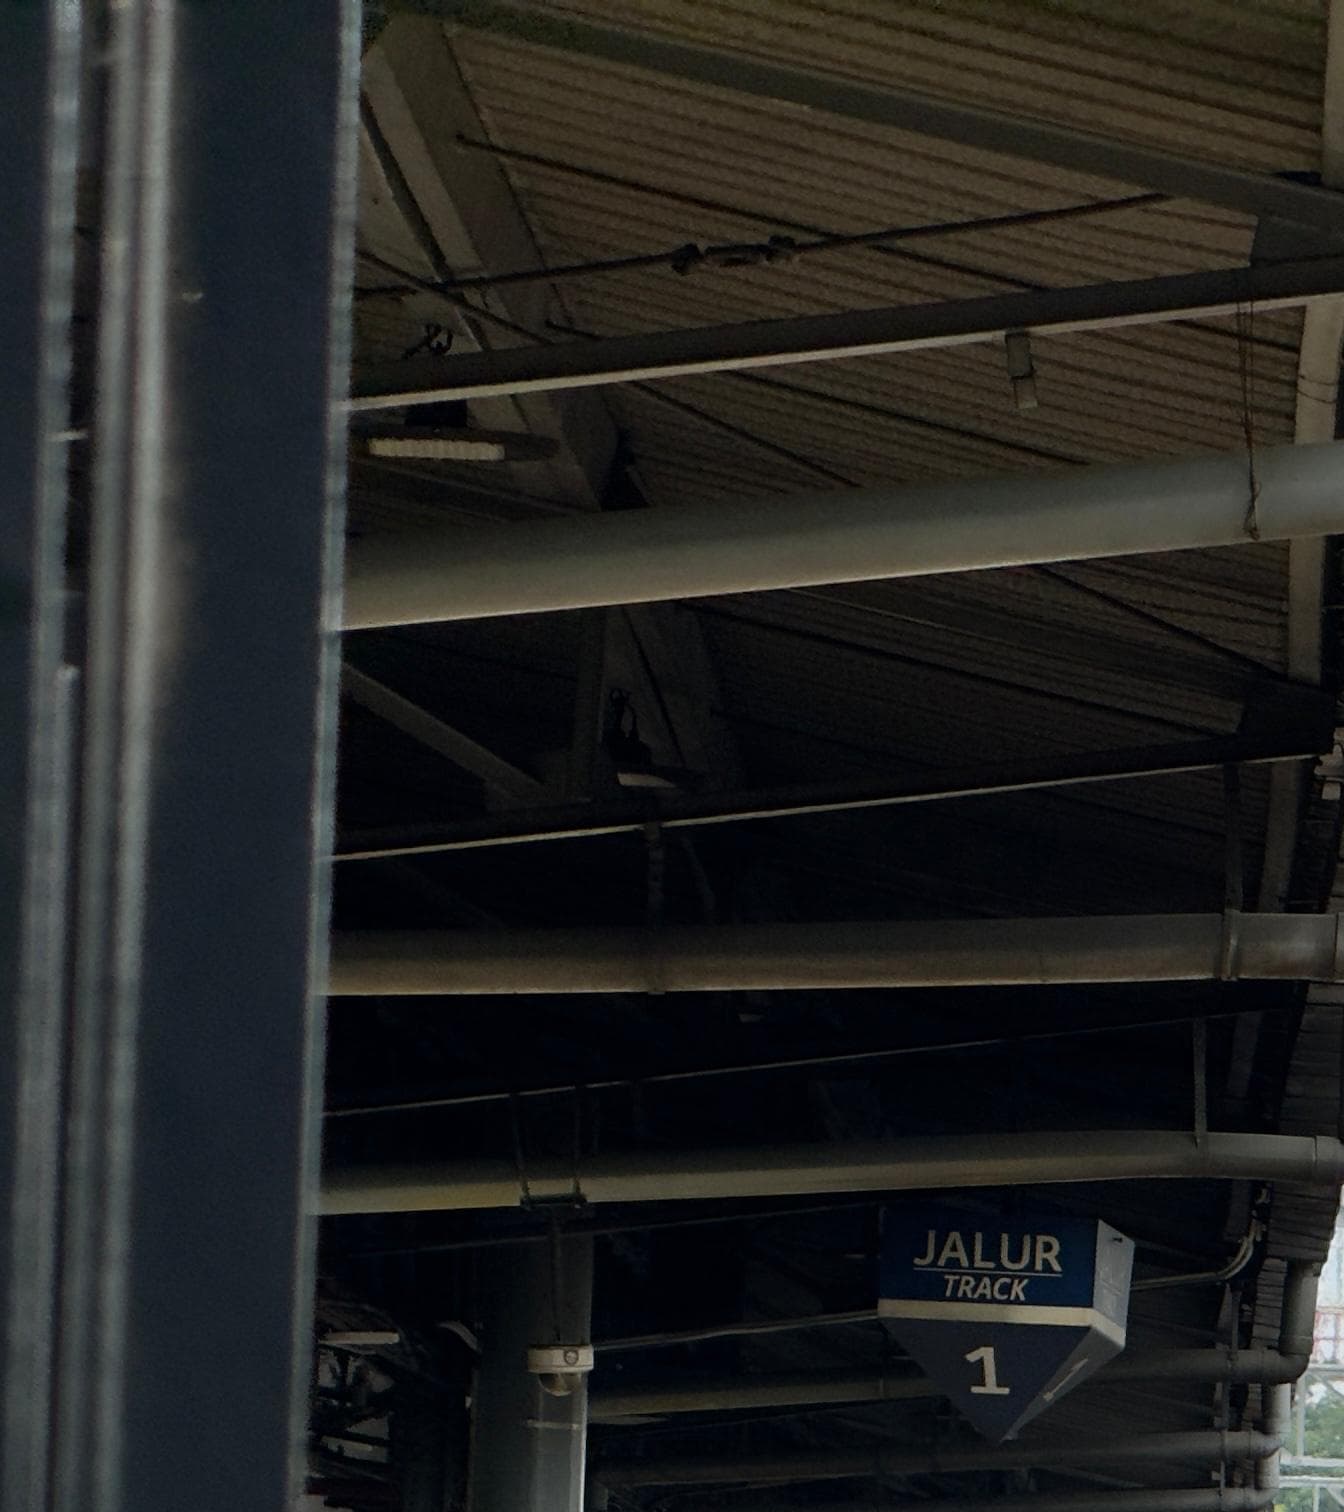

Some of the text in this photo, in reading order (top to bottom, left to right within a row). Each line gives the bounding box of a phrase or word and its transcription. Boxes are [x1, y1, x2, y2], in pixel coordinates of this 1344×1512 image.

[913, 1229, 1063, 1273] JALUR
[943, 1275, 1030, 1301] TRACK
[965, 1346, 1011, 1396] 1
